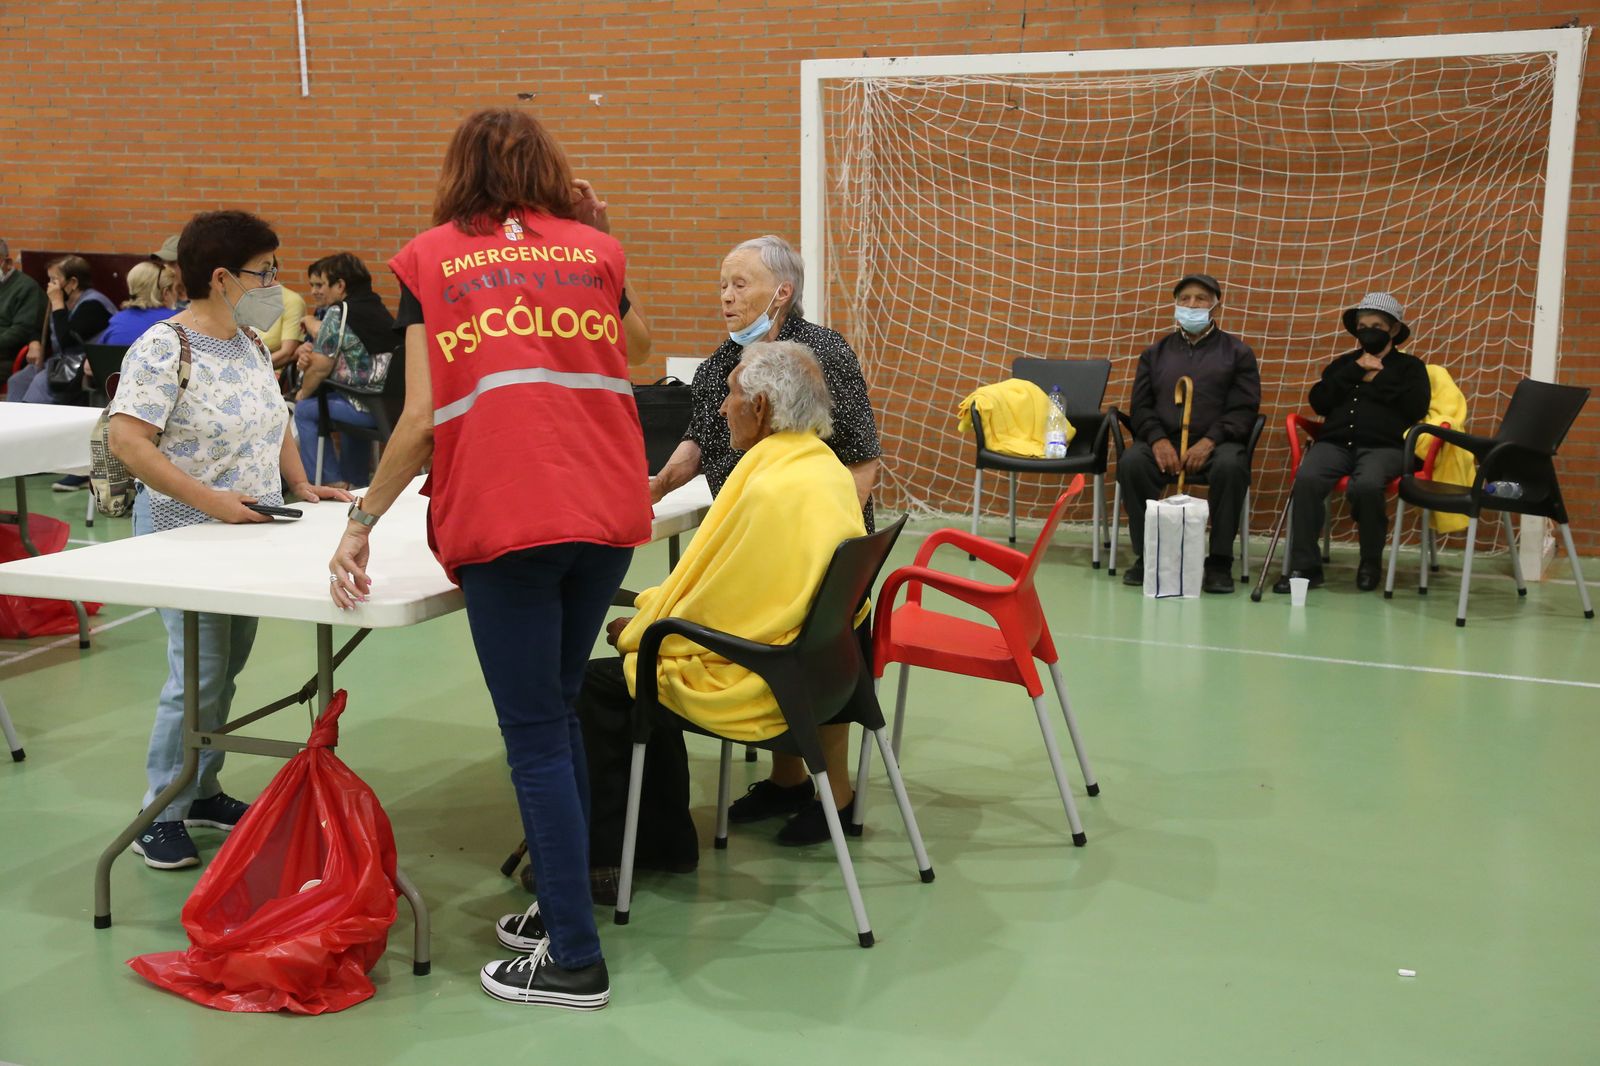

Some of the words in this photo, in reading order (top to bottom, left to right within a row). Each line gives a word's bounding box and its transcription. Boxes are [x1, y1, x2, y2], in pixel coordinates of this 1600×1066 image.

[441, 246, 597, 278] EMERGENCIAS
[443, 268, 526, 304] Castilla
[533, 271, 547, 289] y
[554, 269, 604, 290] León
[435, 296, 619, 363] PSICÓLOGO
